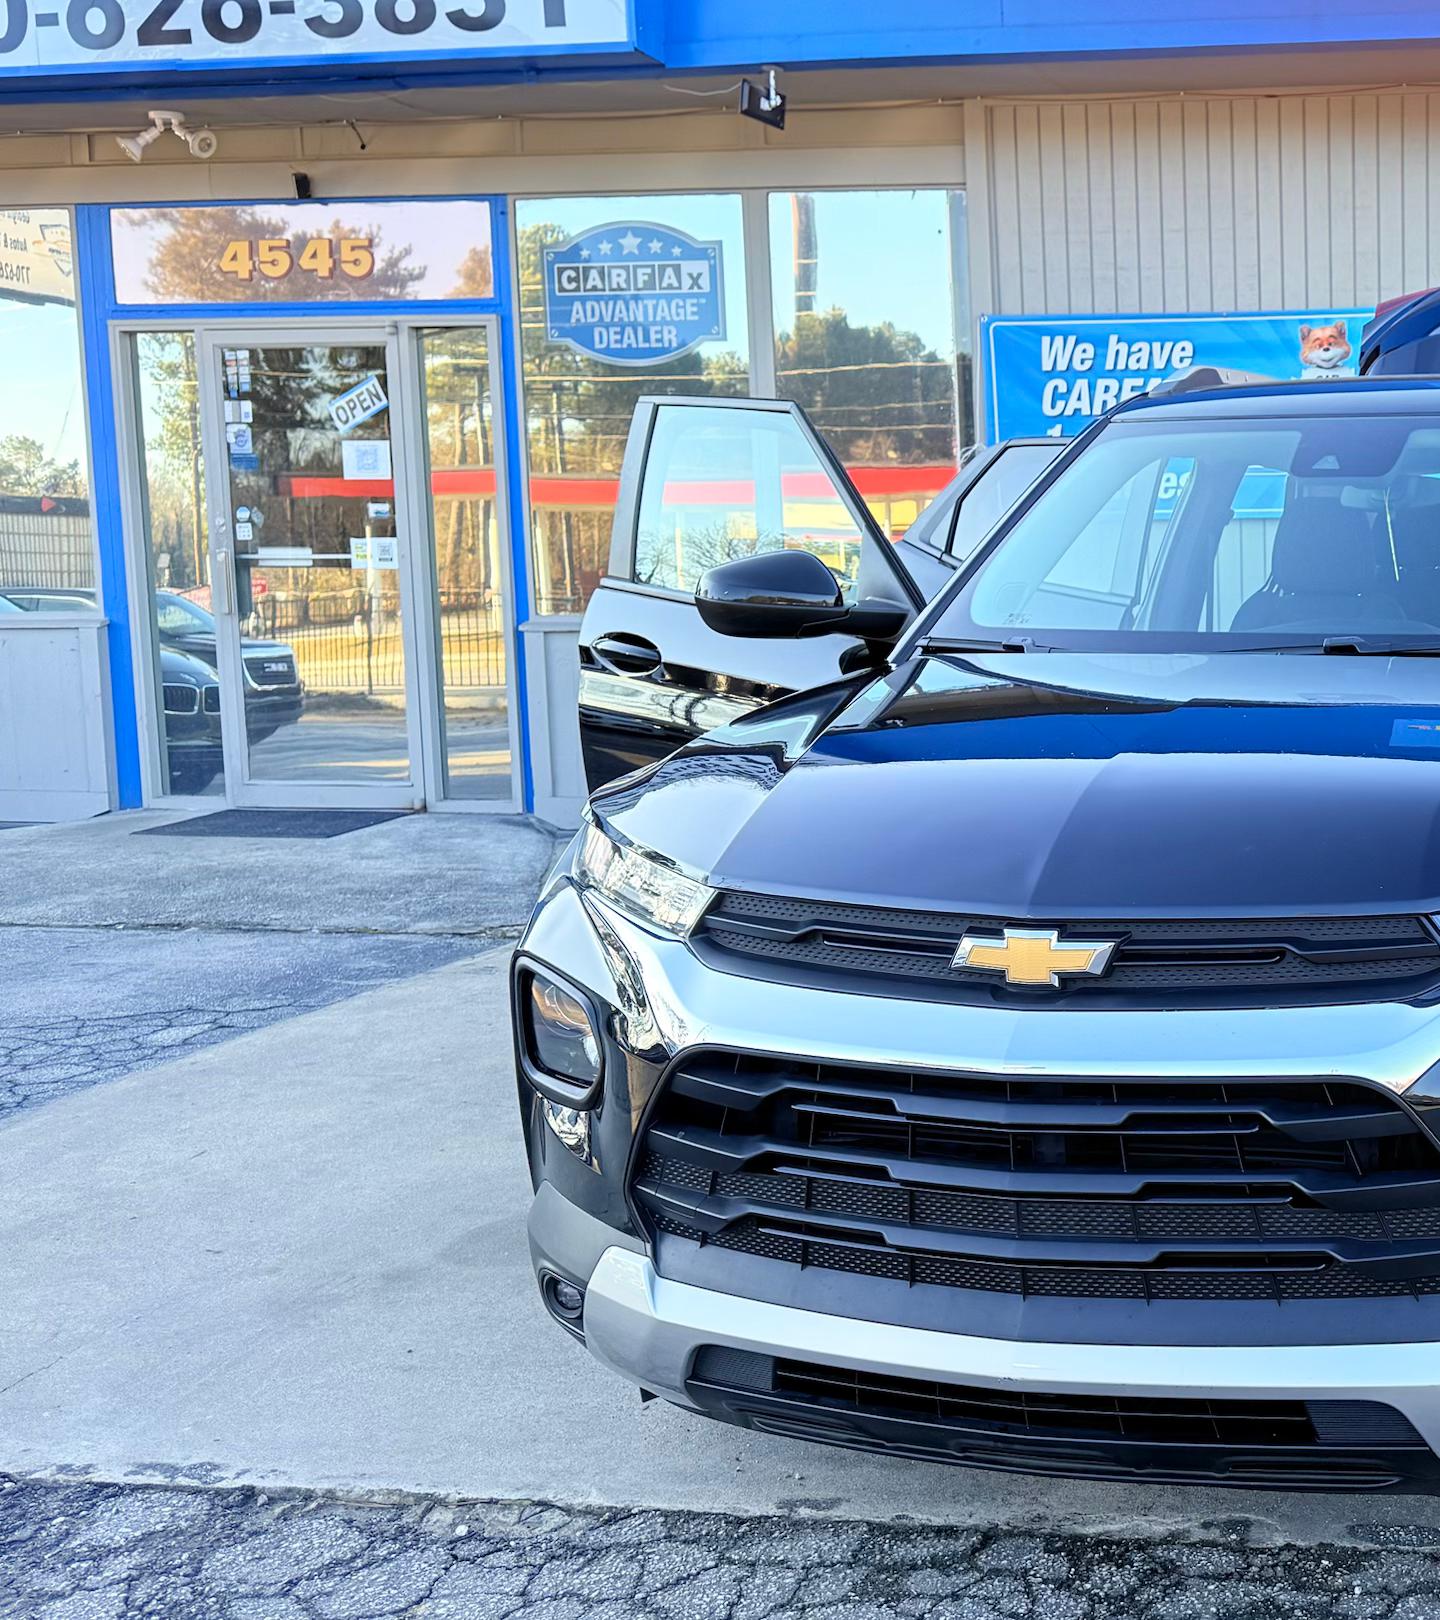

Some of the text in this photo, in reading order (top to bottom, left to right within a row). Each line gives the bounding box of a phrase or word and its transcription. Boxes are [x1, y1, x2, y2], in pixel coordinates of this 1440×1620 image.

[219, 238, 375, 281] 4545
[559, 265, 704, 291] CARFAX
[570, 299, 700, 324] ADVANTAGE
[593, 325, 678, 349] DEALER
[1041, 334, 1194, 372] We have
[335, 383, 383, 425] OPEN
[1041, 378, 1163, 417] CARF
